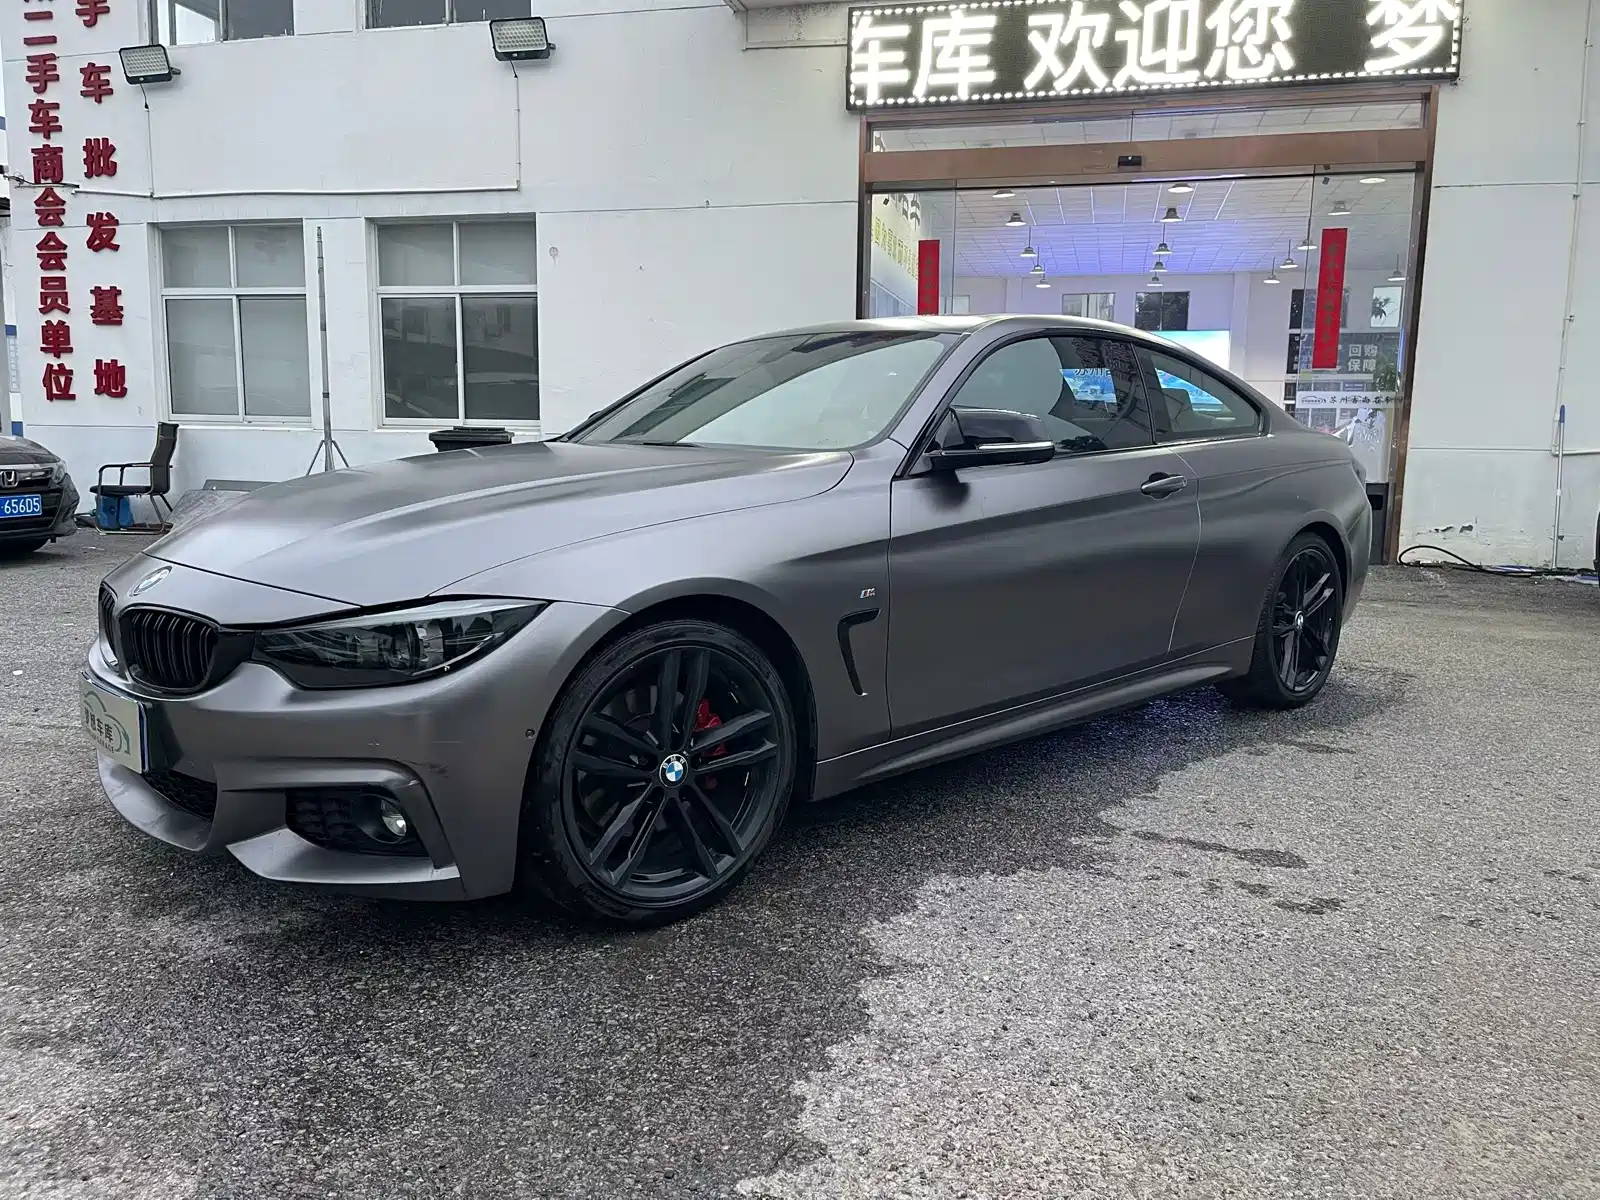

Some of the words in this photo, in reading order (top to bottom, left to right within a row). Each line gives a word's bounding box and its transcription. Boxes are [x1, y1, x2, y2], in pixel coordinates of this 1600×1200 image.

[1023, 0, 1296, 91] 欢迎您
[23, 0, 76, 402] 二手车商会会员单位
